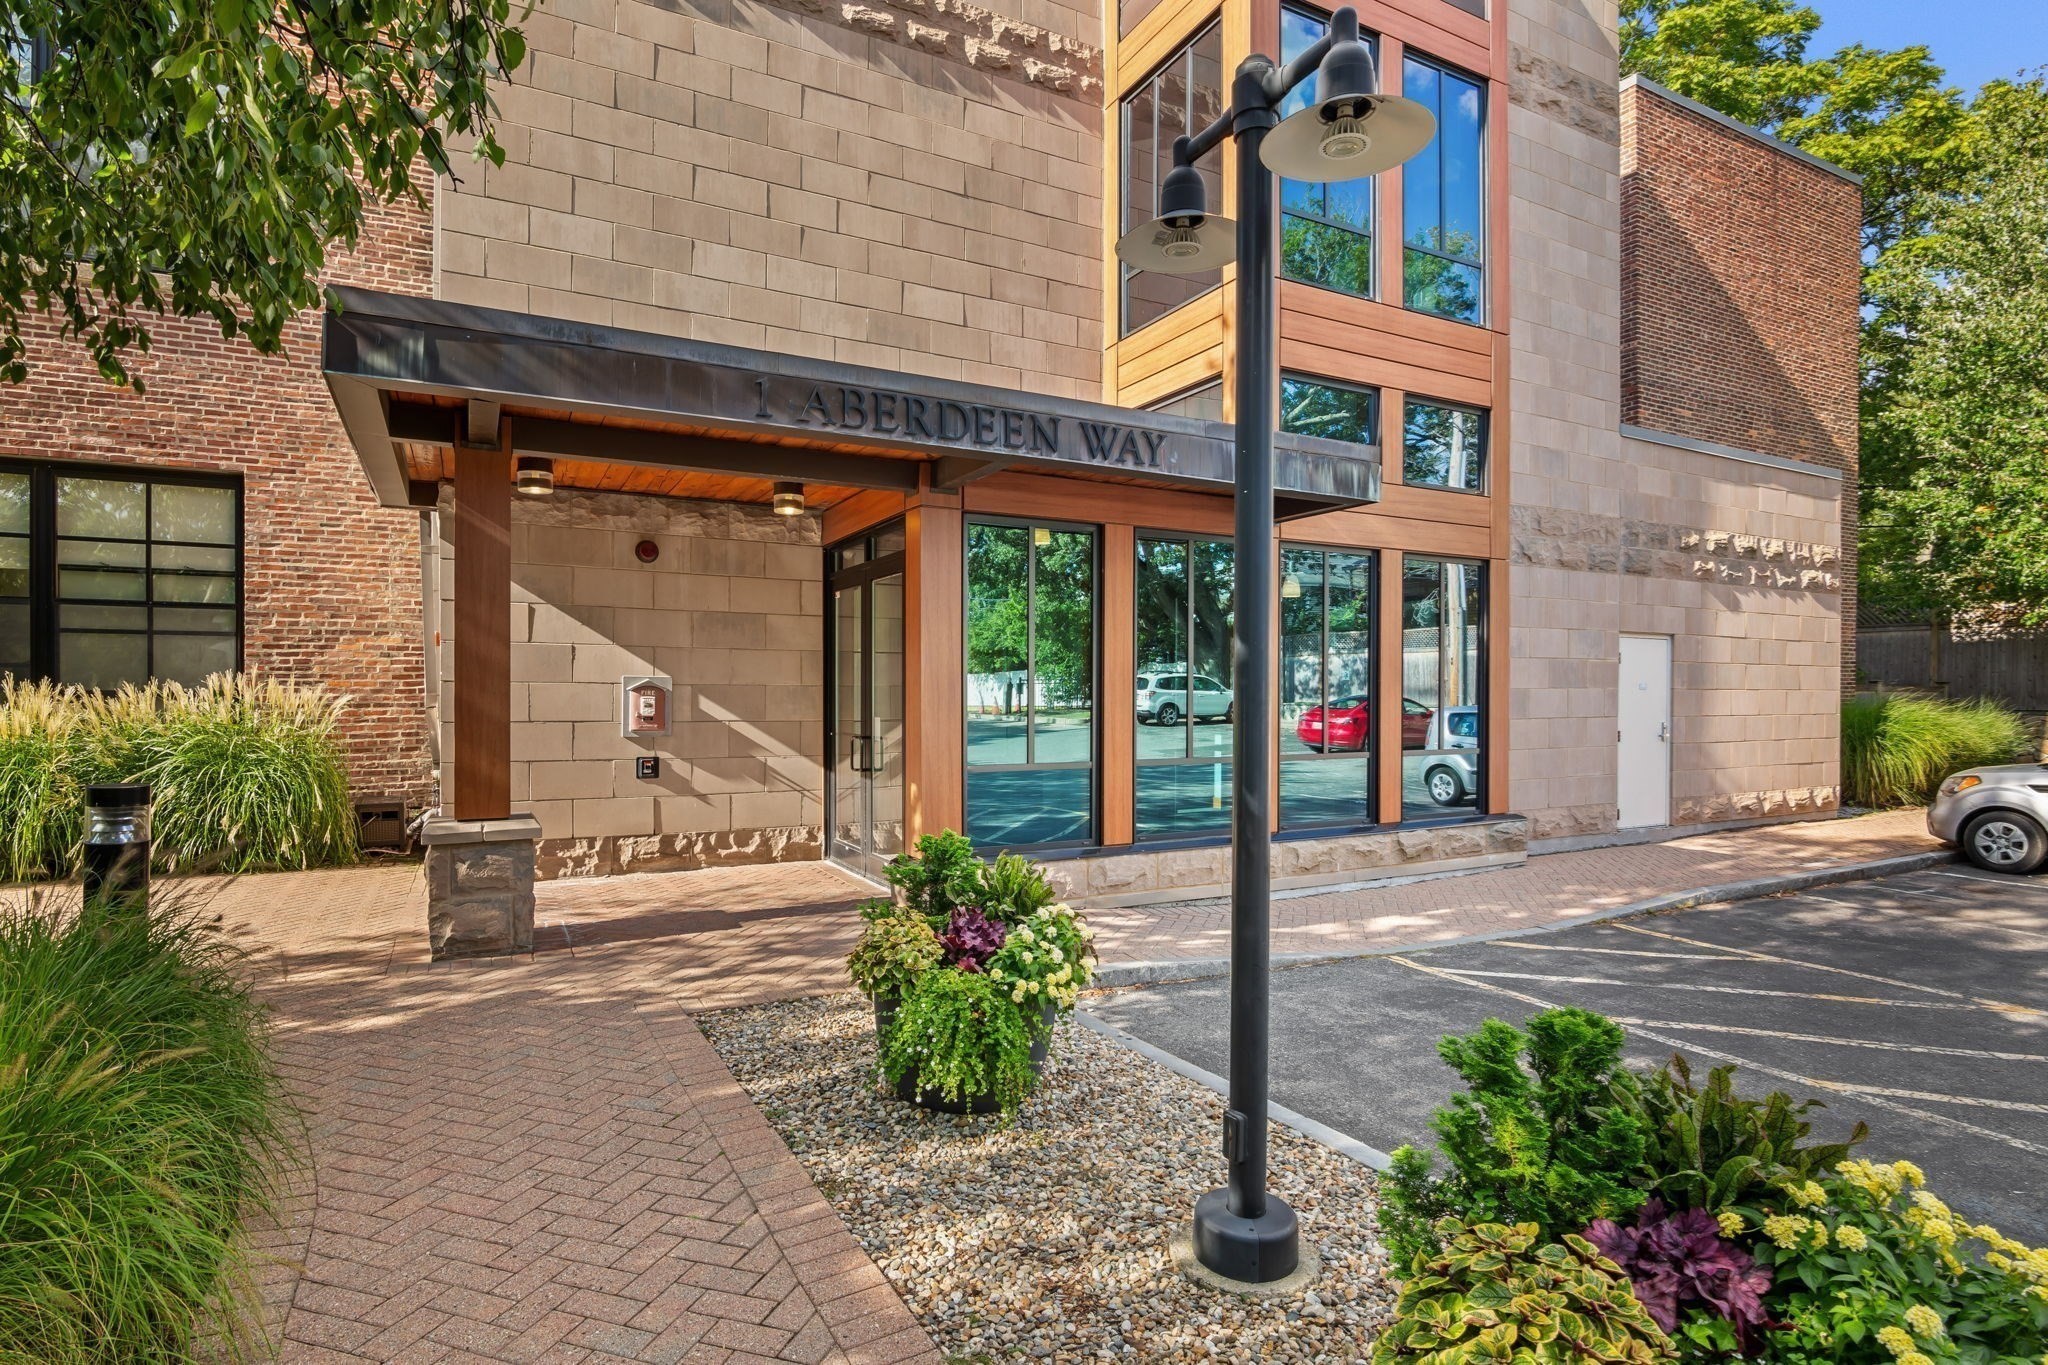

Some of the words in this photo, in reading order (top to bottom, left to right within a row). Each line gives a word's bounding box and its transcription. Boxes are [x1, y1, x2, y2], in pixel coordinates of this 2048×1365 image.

[755, 377, 774, 418] 1
[798, 385, 1062, 453] ABERDEEN
[1079, 421, 1168, 466] WAY
